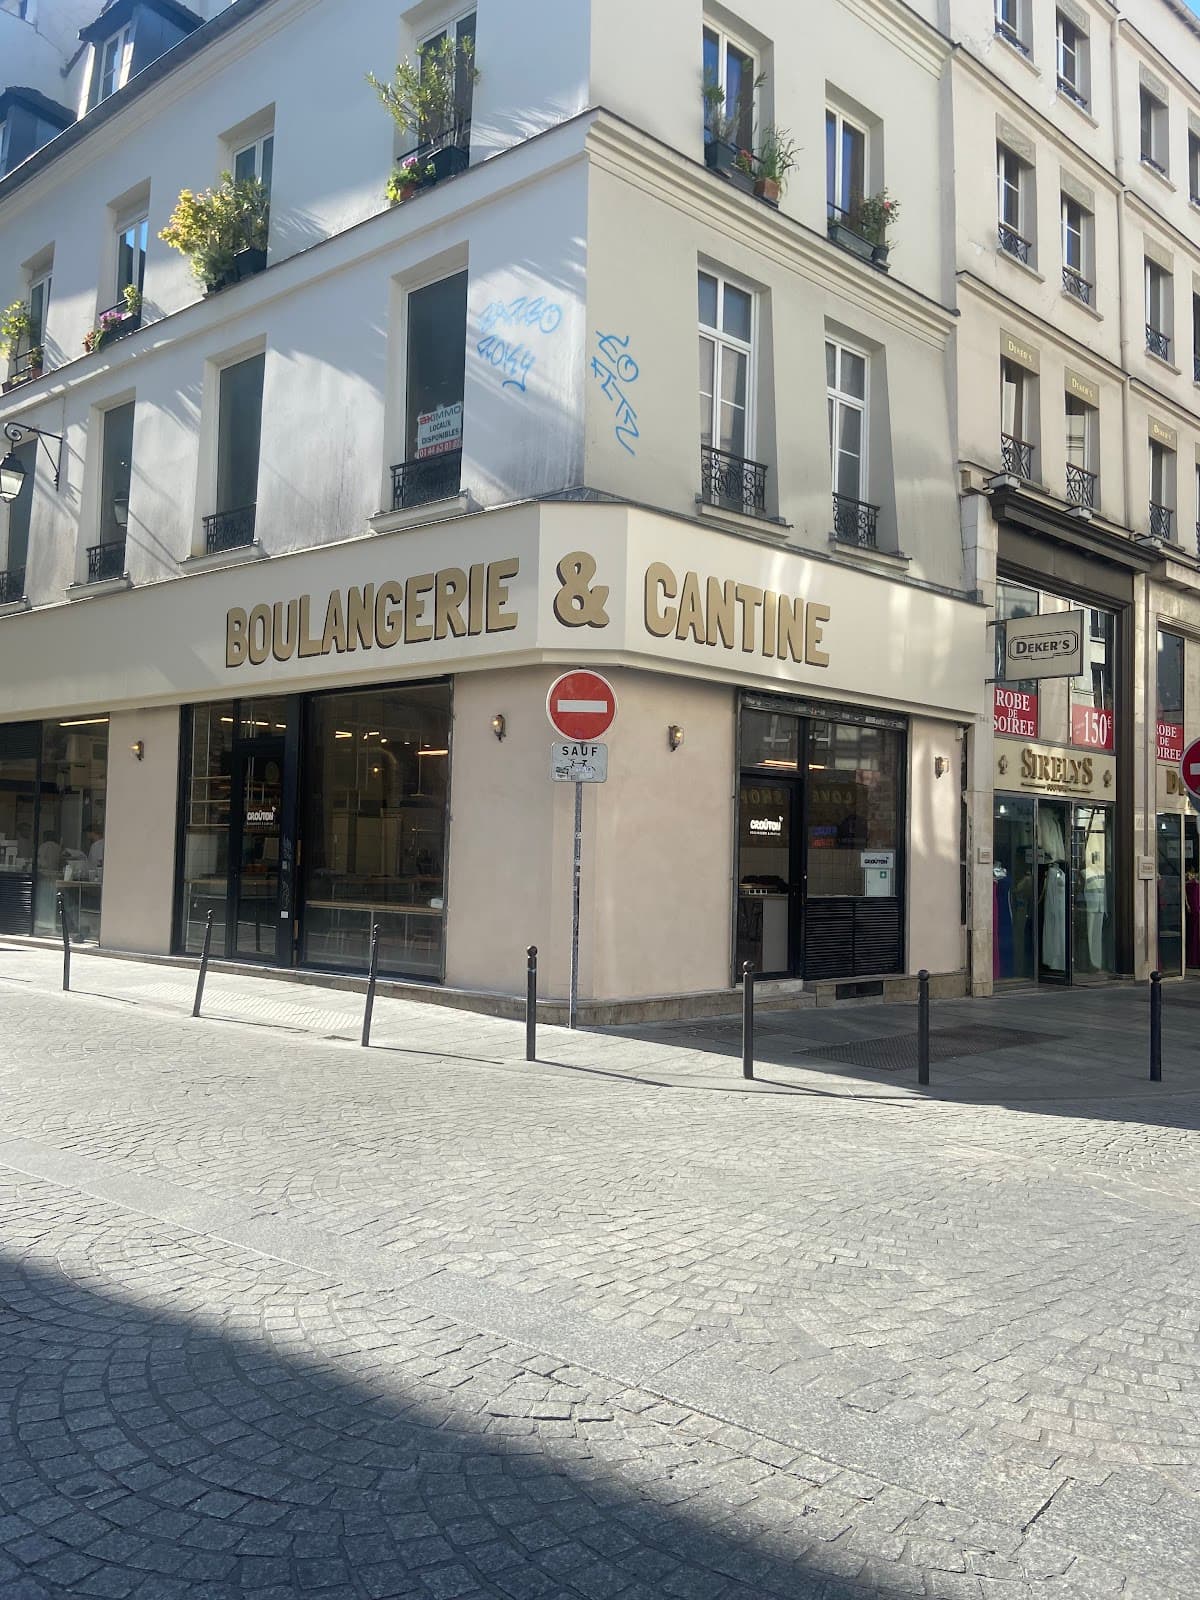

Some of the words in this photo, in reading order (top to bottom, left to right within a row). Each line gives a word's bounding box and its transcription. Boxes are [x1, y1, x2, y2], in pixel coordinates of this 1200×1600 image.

[421, 428, 459, 444] DISPONIBLES
[226, 557, 519, 668] BOULANGERIE
[553, 551, 609, 628] &
[644, 562, 830, 667] CANTINE
[1015, 640, 1070, 654] DEKER'S
[995, 689, 1030, 711] ROBE
[1008, 708, 1018, 719] DE
[1160, 737, 1169, 746] DE
[562, 746, 598, 756] SAUF
[1021, 748, 1093, 785] SIRELYS
